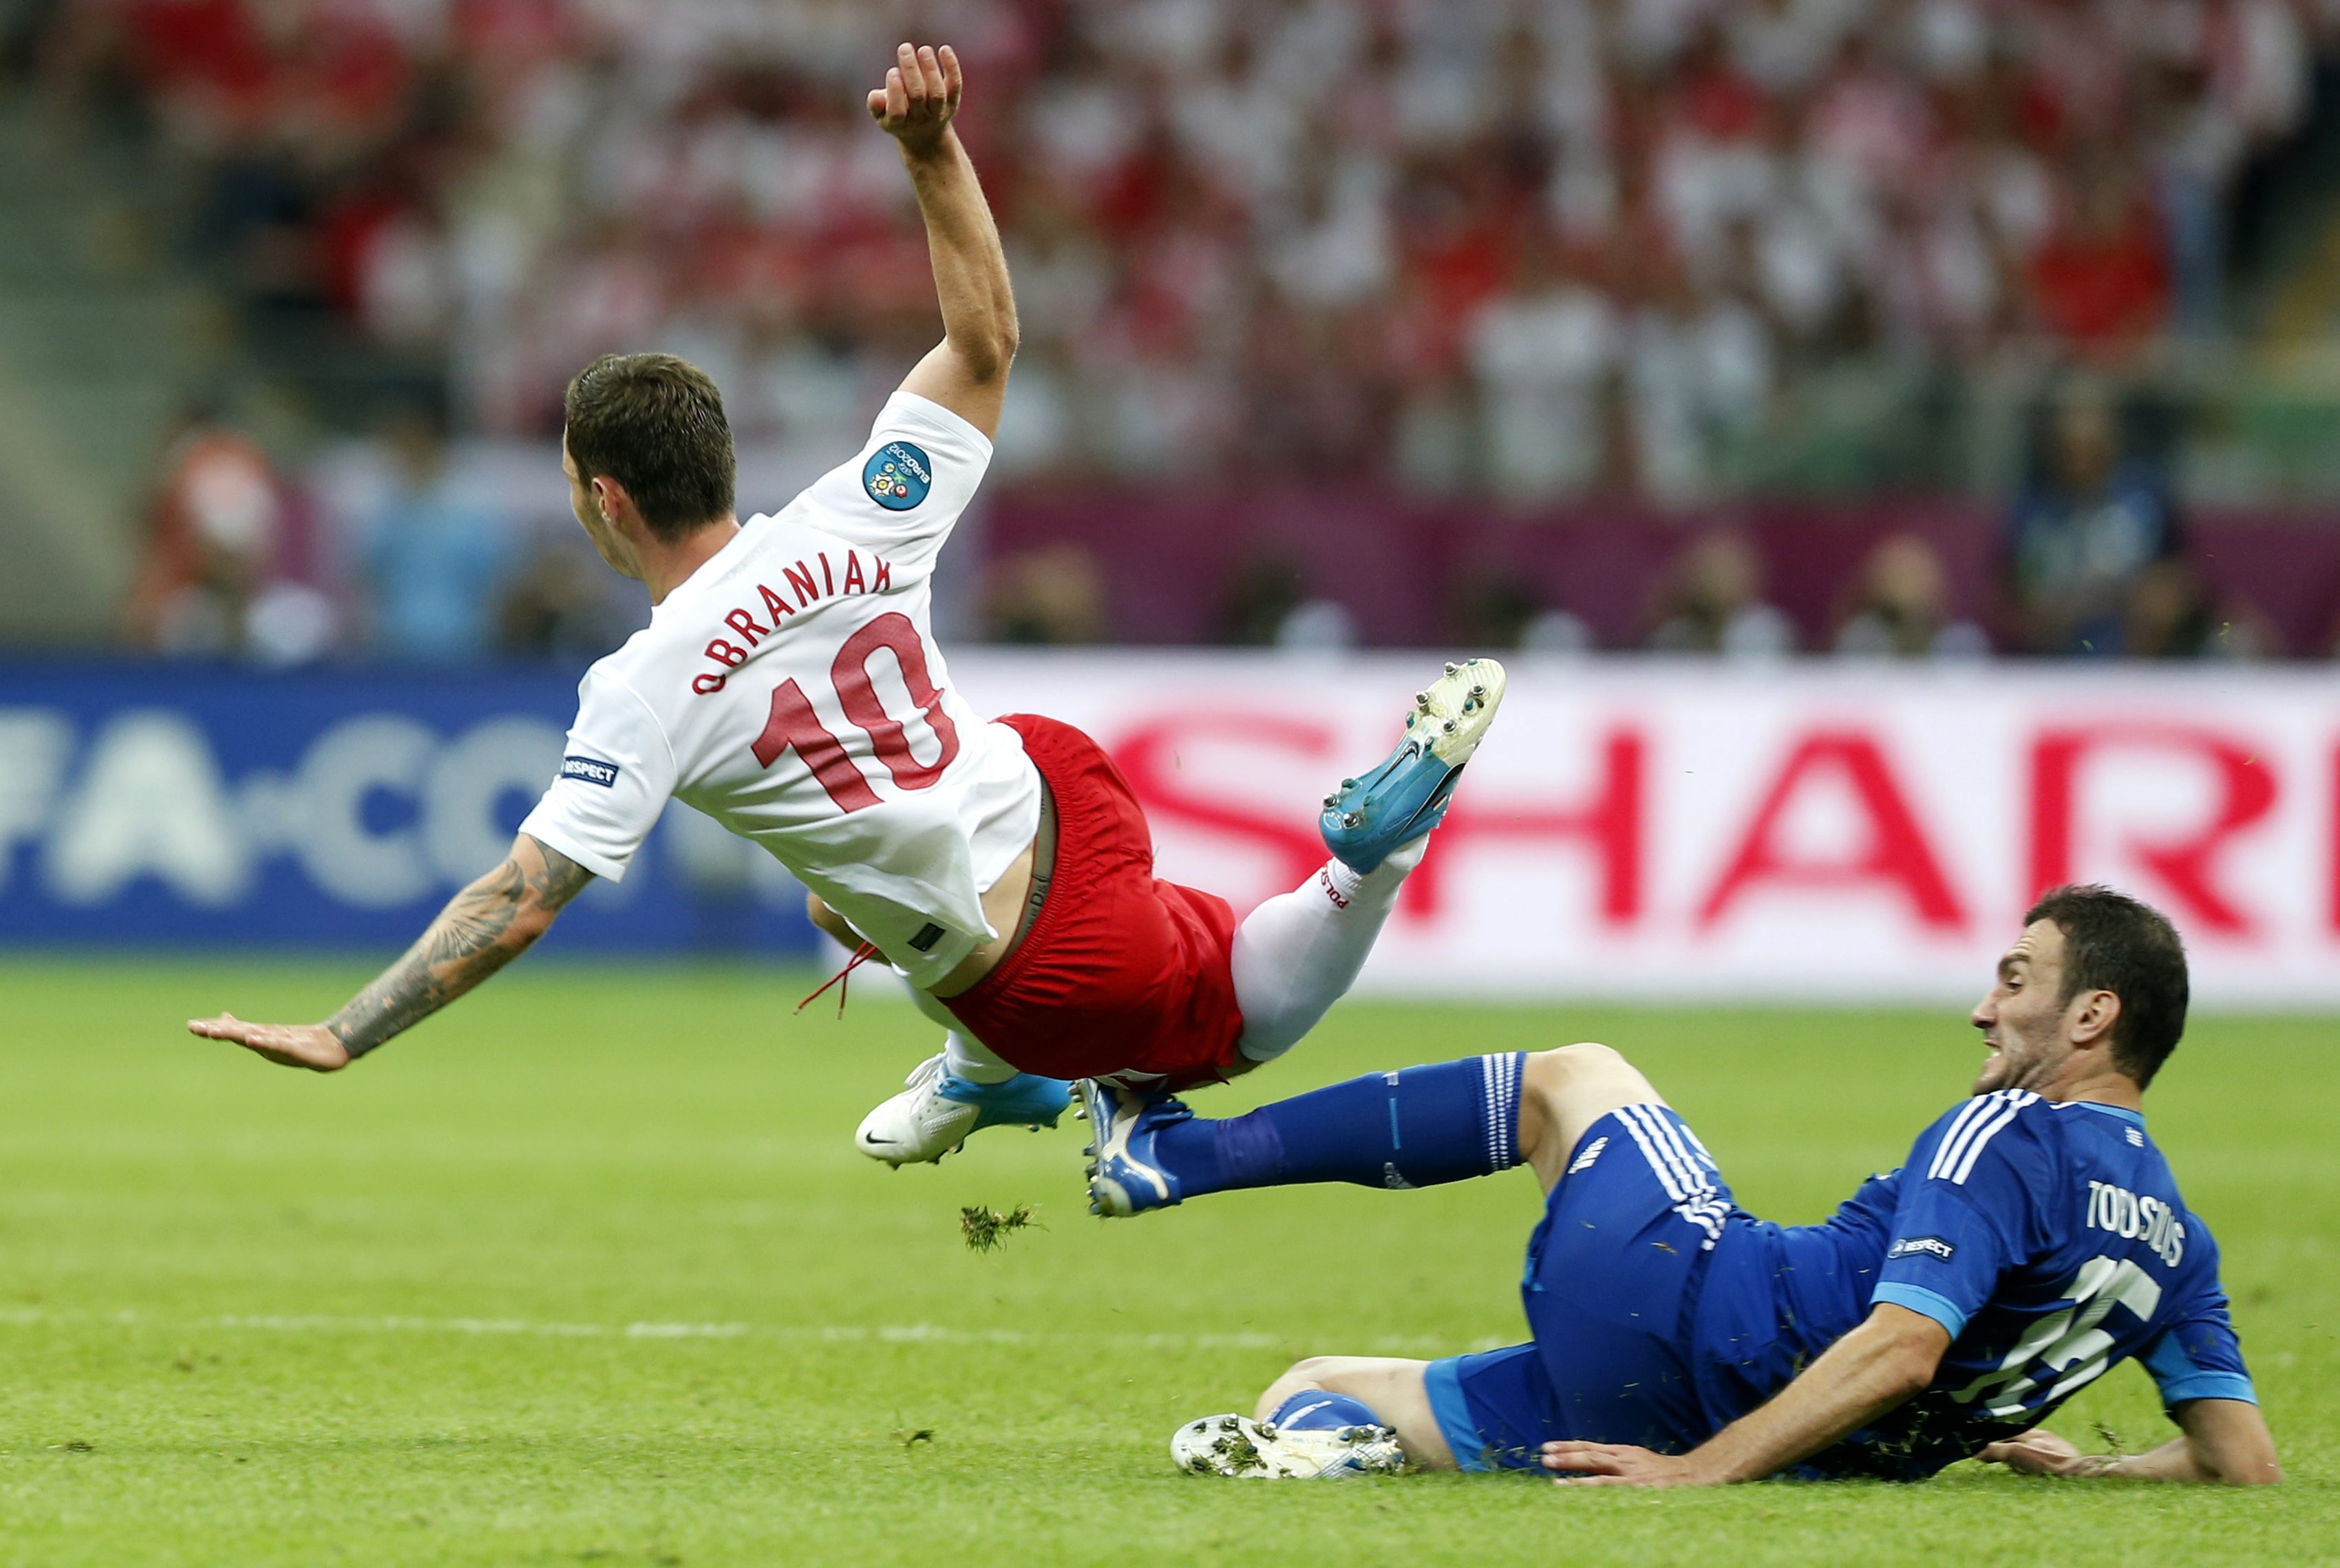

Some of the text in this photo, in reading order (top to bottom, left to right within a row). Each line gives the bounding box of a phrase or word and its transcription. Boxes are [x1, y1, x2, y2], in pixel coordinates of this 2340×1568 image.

[692, 549, 892, 696] OBRANIAK
[750, 611, 961, 813] 10
[1111, 709, 2340, 943] SHAR
